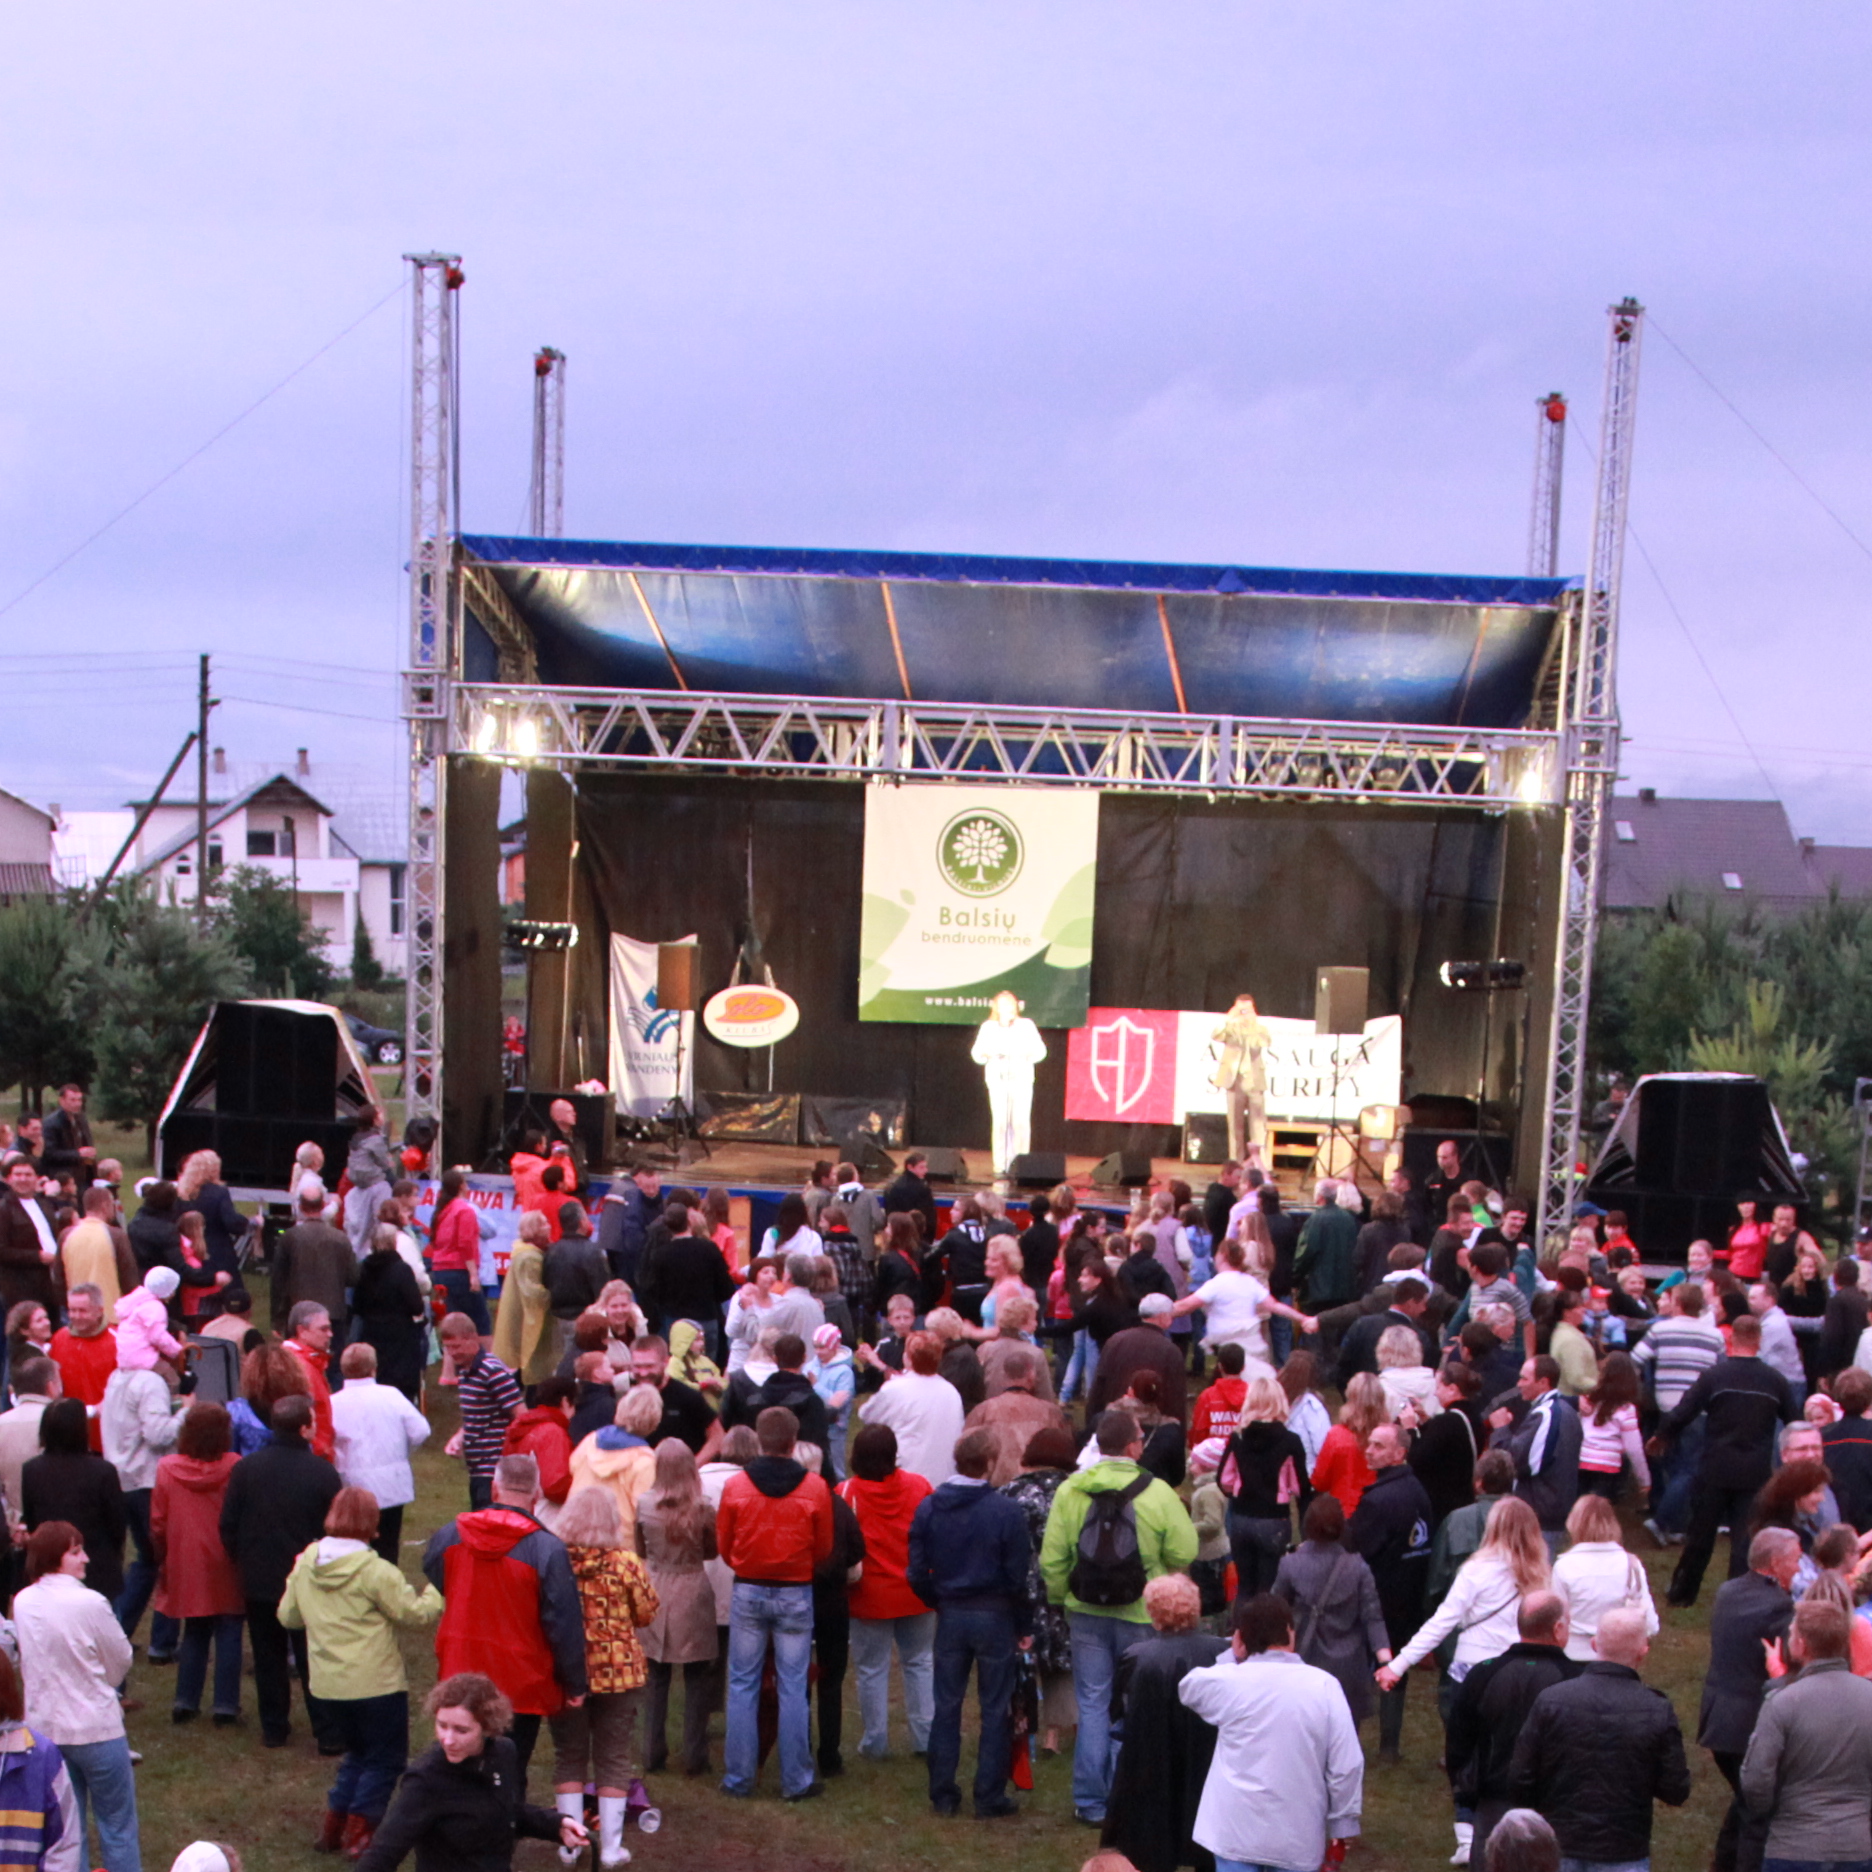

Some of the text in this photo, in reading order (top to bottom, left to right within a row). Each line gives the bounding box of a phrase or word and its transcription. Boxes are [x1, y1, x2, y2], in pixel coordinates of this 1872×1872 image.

[939, 906, 1016, 934] Balsių
[1209, 1410, 1242, 1424] WAV
[1209, 1424, 1233, 1436] RID
